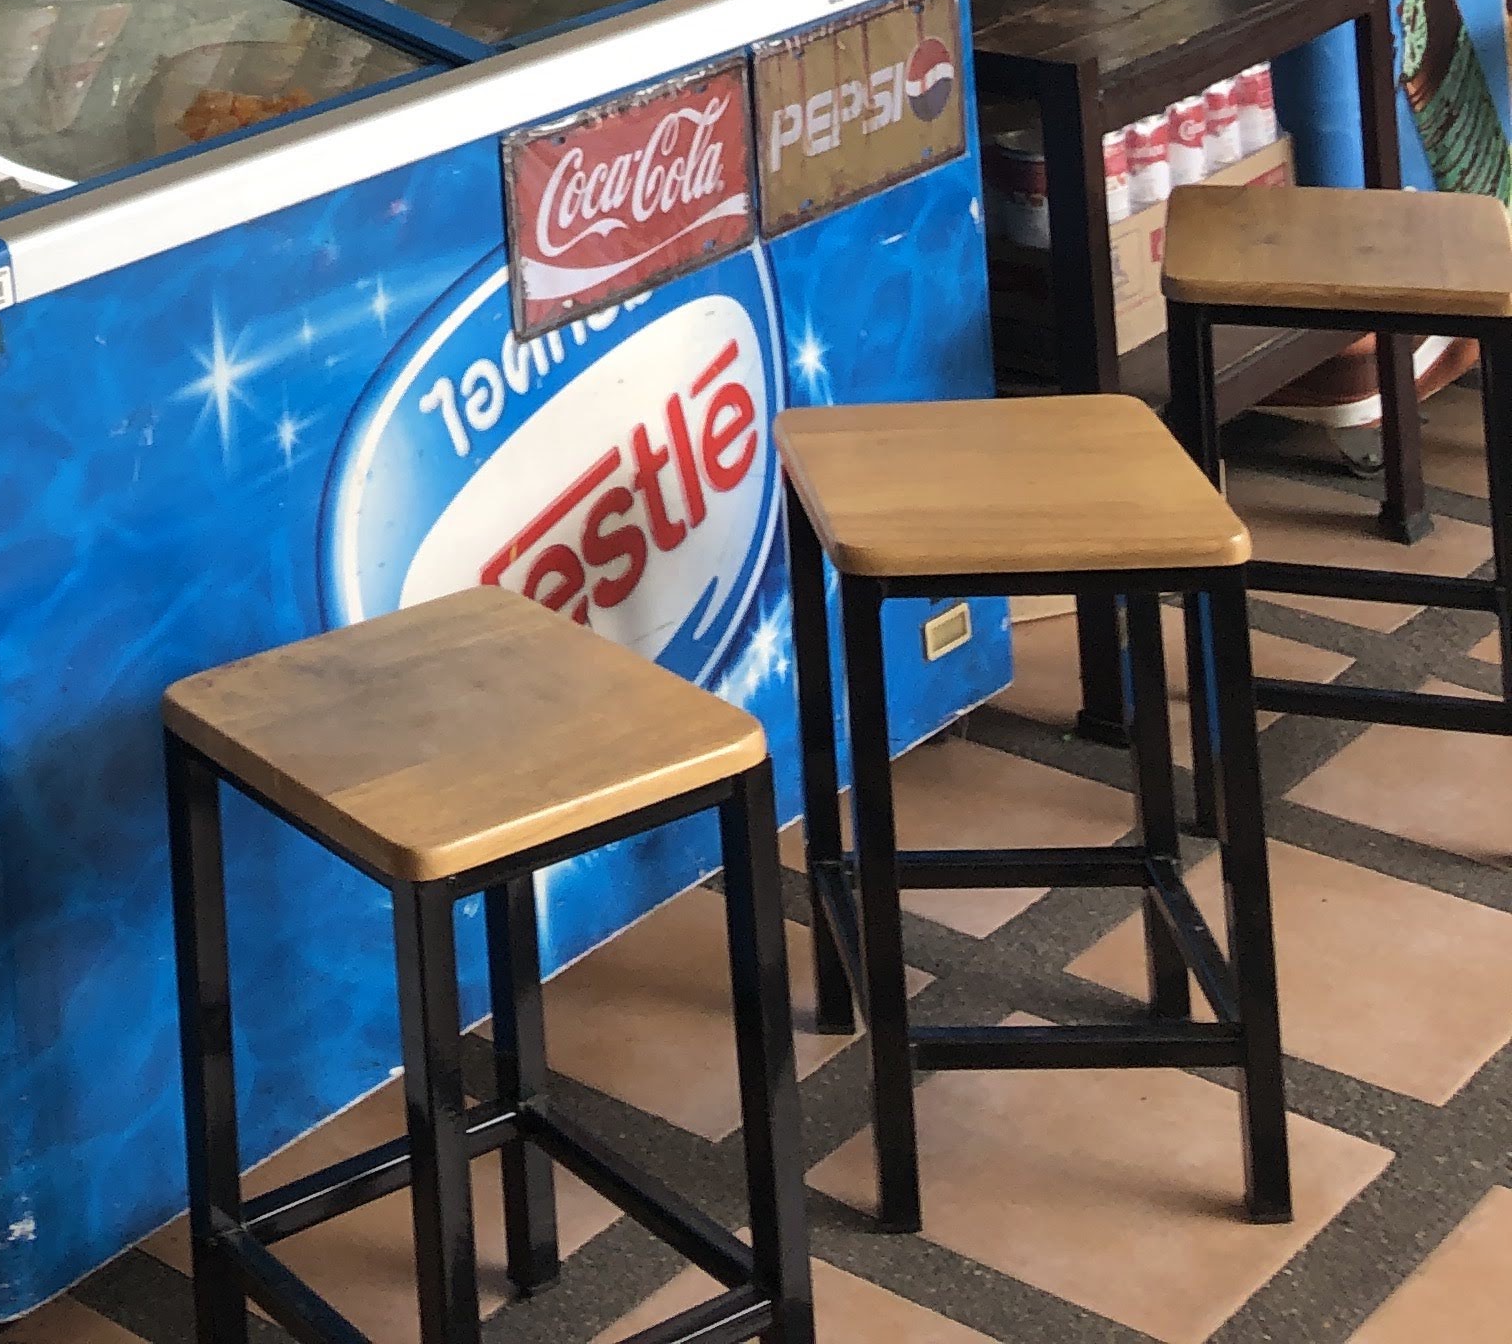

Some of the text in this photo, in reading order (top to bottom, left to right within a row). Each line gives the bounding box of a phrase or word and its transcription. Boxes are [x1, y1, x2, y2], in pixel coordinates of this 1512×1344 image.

[536, 91, 733, 258] Coca-Cola
[768, 63, 904, 174] PEPSI
[478, 337, 759, 625] estlé
